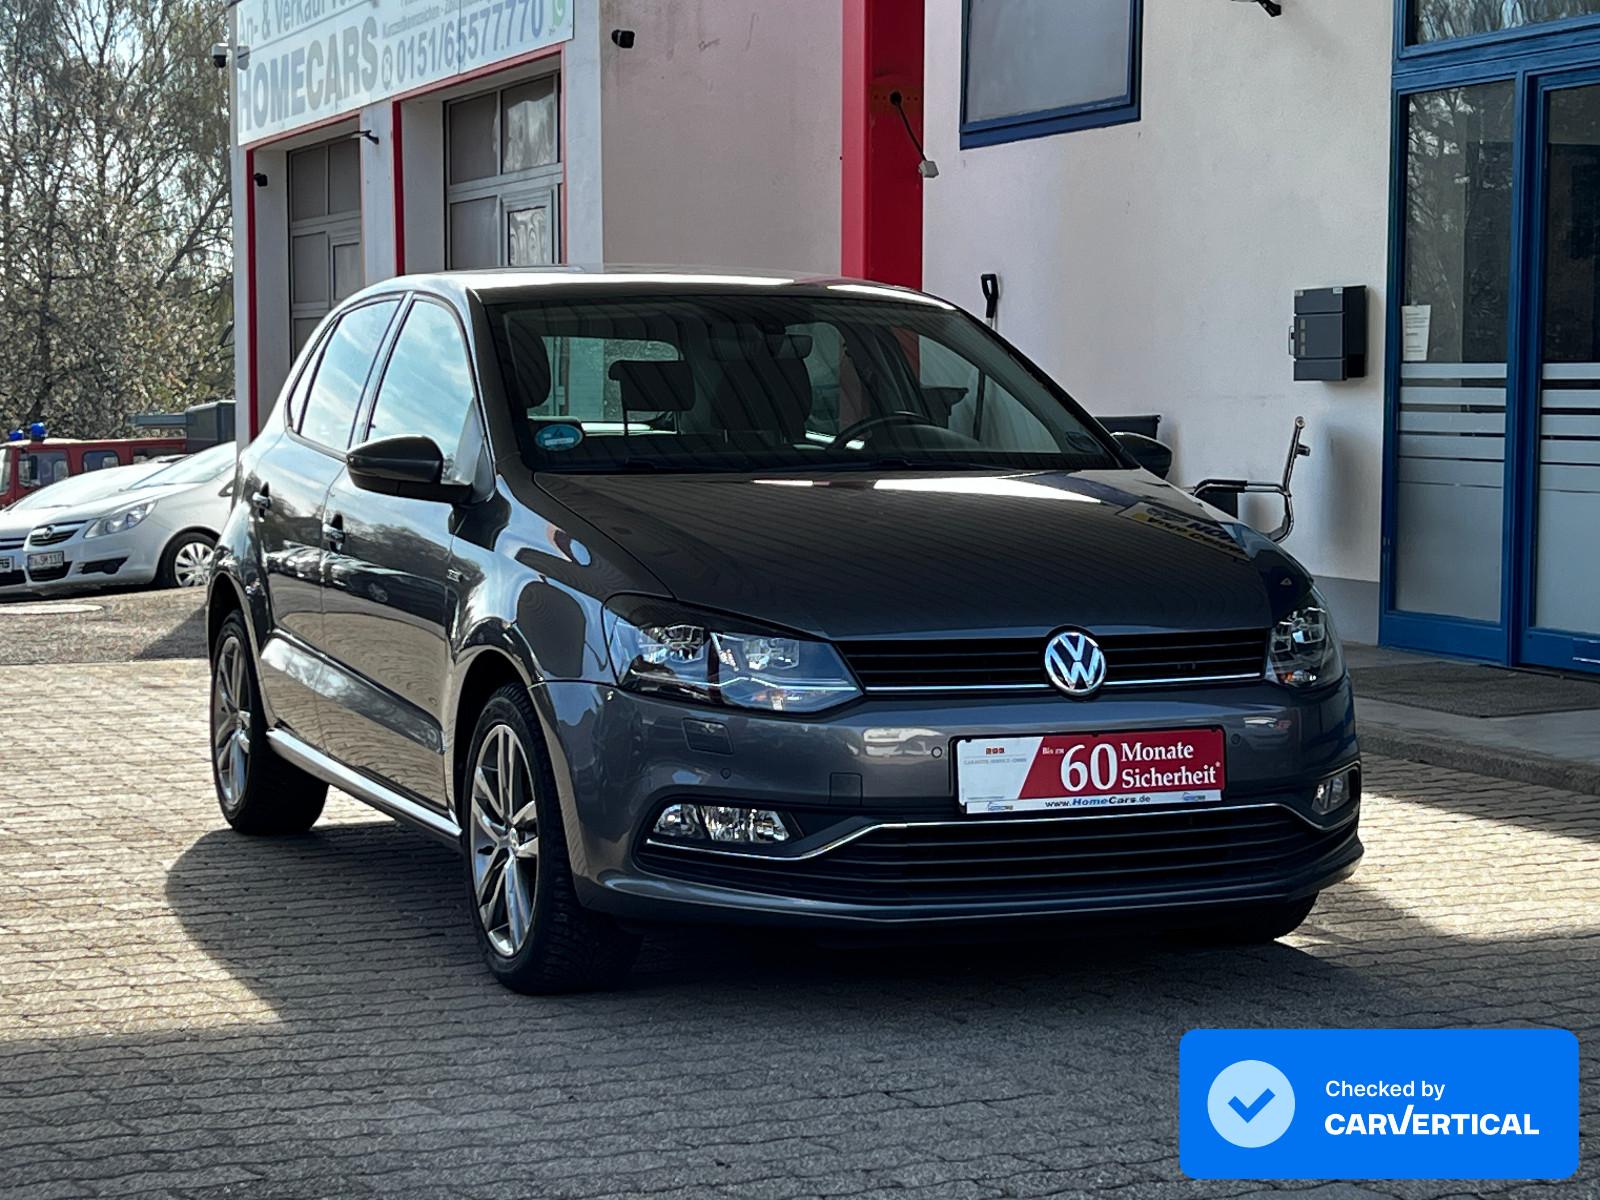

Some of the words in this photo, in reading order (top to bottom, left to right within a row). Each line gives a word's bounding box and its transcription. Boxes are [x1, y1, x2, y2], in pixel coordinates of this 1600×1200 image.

[262, 0, 271, 40] &
[237, 16, 379, 133] HOMECARS
[1061, 743, 1118, 791] 60
[1121, 742, 1194, 761] Monate
[1045, 795, 1151, 808] www.HomeCars.de
